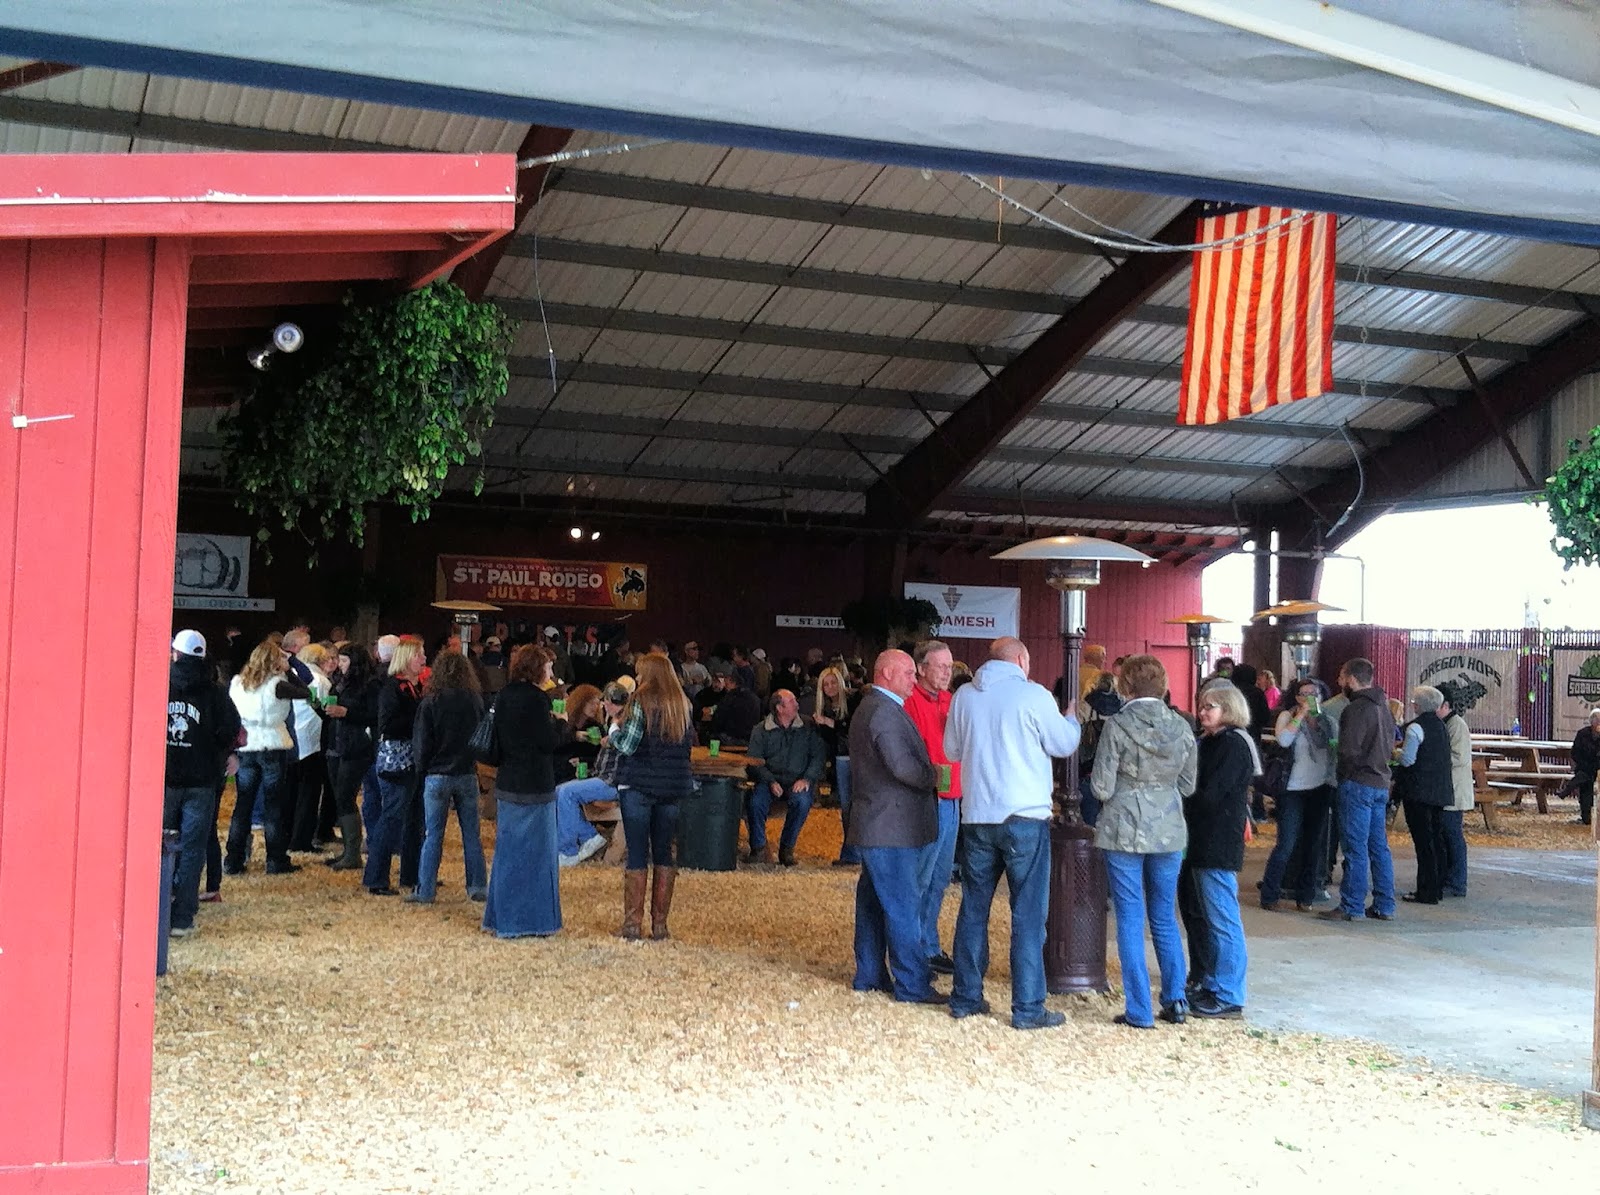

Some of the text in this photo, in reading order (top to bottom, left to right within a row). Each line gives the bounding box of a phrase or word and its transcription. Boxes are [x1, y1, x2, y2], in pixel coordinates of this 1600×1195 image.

[453, 567, 604, 589] ST. PAUL RODEO
[487, 586, 526, 600] JULY
[941, 614, 995, 628] AMESH
[1420, 655, 1502, 688] OREGON HOPS
